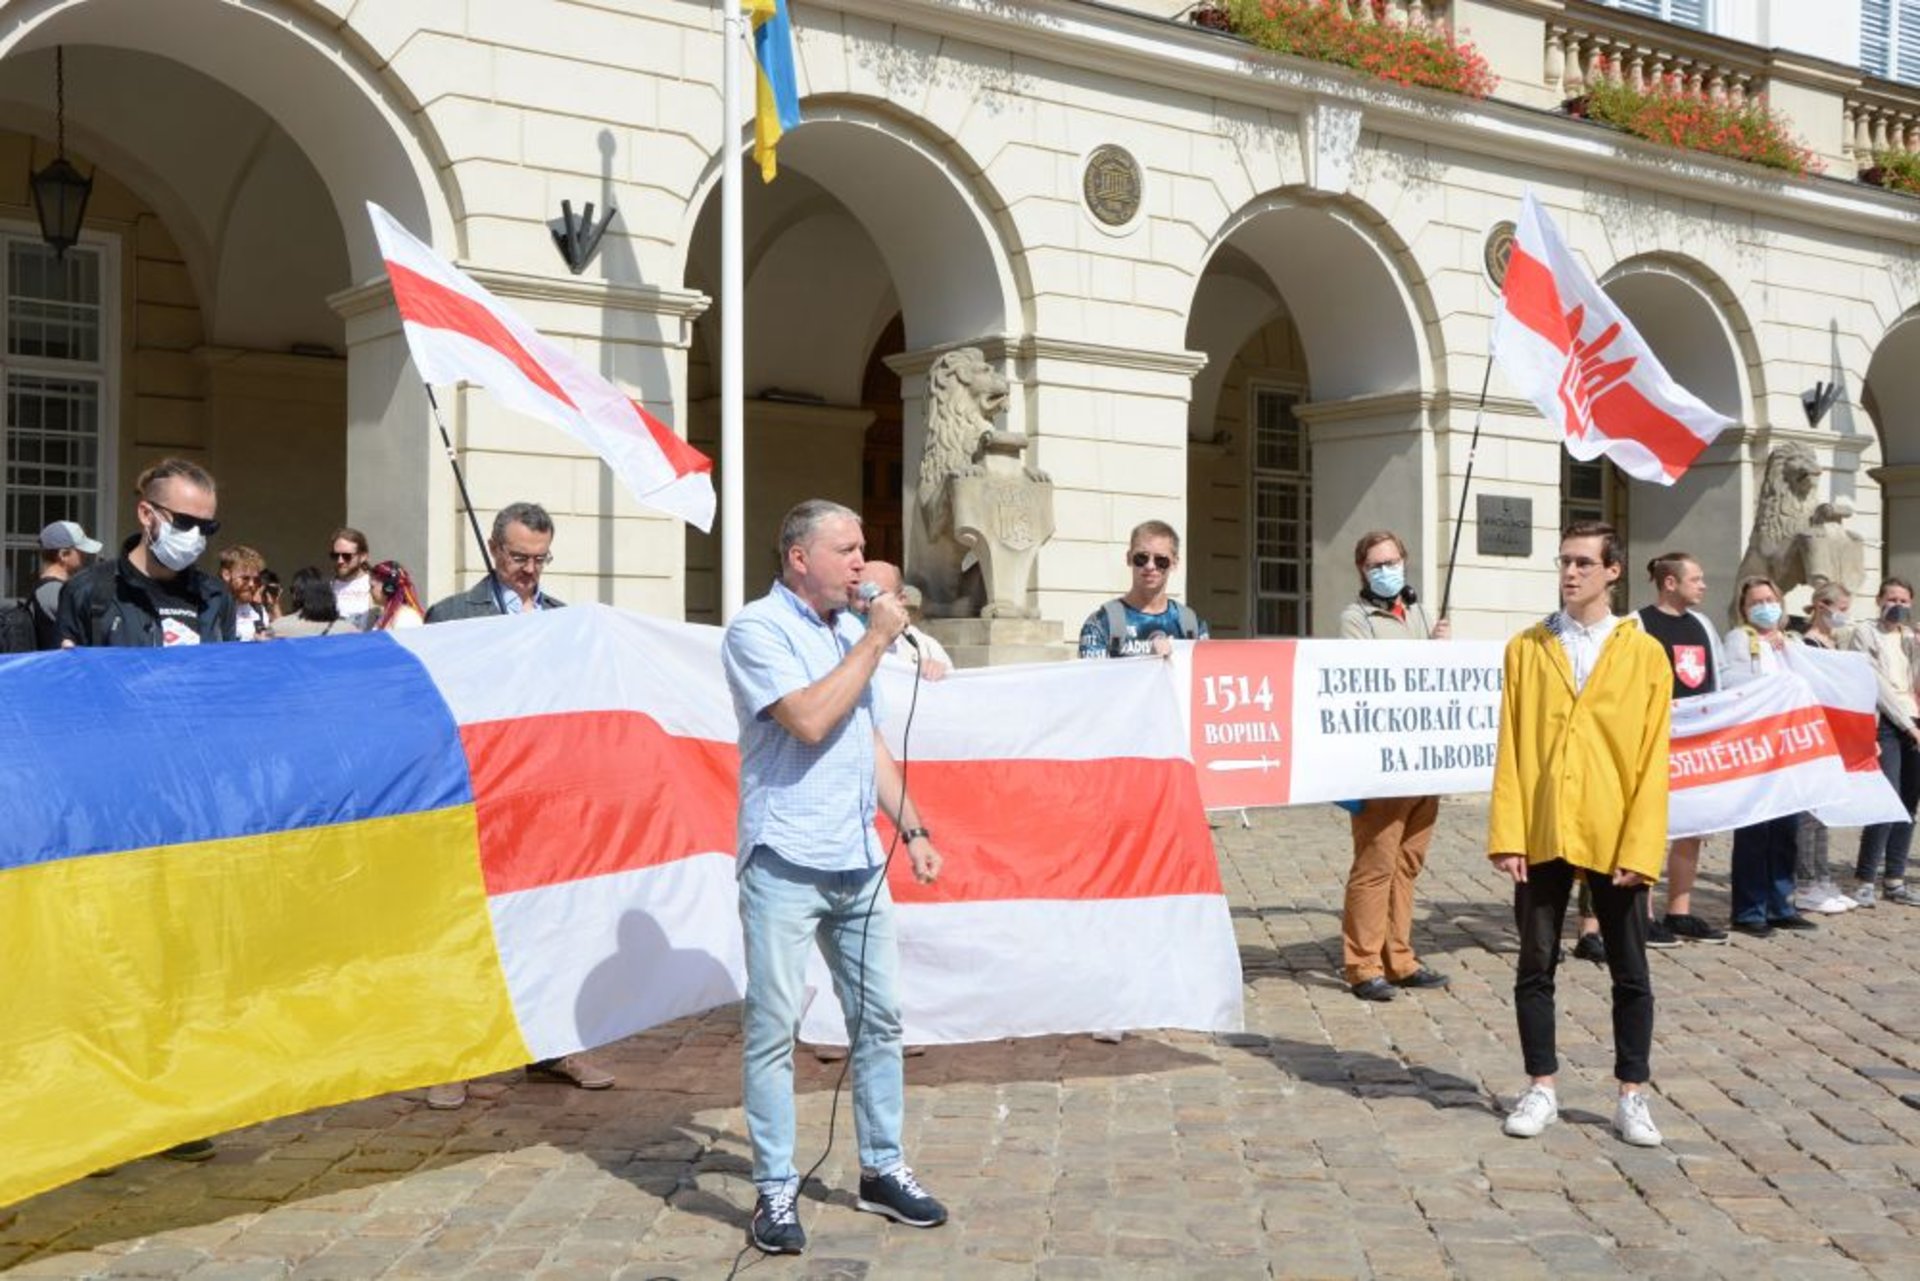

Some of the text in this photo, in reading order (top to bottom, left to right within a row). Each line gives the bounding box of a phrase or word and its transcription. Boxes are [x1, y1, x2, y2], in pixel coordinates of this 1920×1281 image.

[1202, 675, 1273, 713] 1514
[1316, 667, 1397, 698] ДЗЕНЬ
[1204, 721, 1281, 745] ВОРША
[1319, 699, 1500, 736] ВАЙСКОВАЙ СЛ
[1779, 720, 1826, 755] ЛУГ
[1380, 746, 1409, 774] ВА
